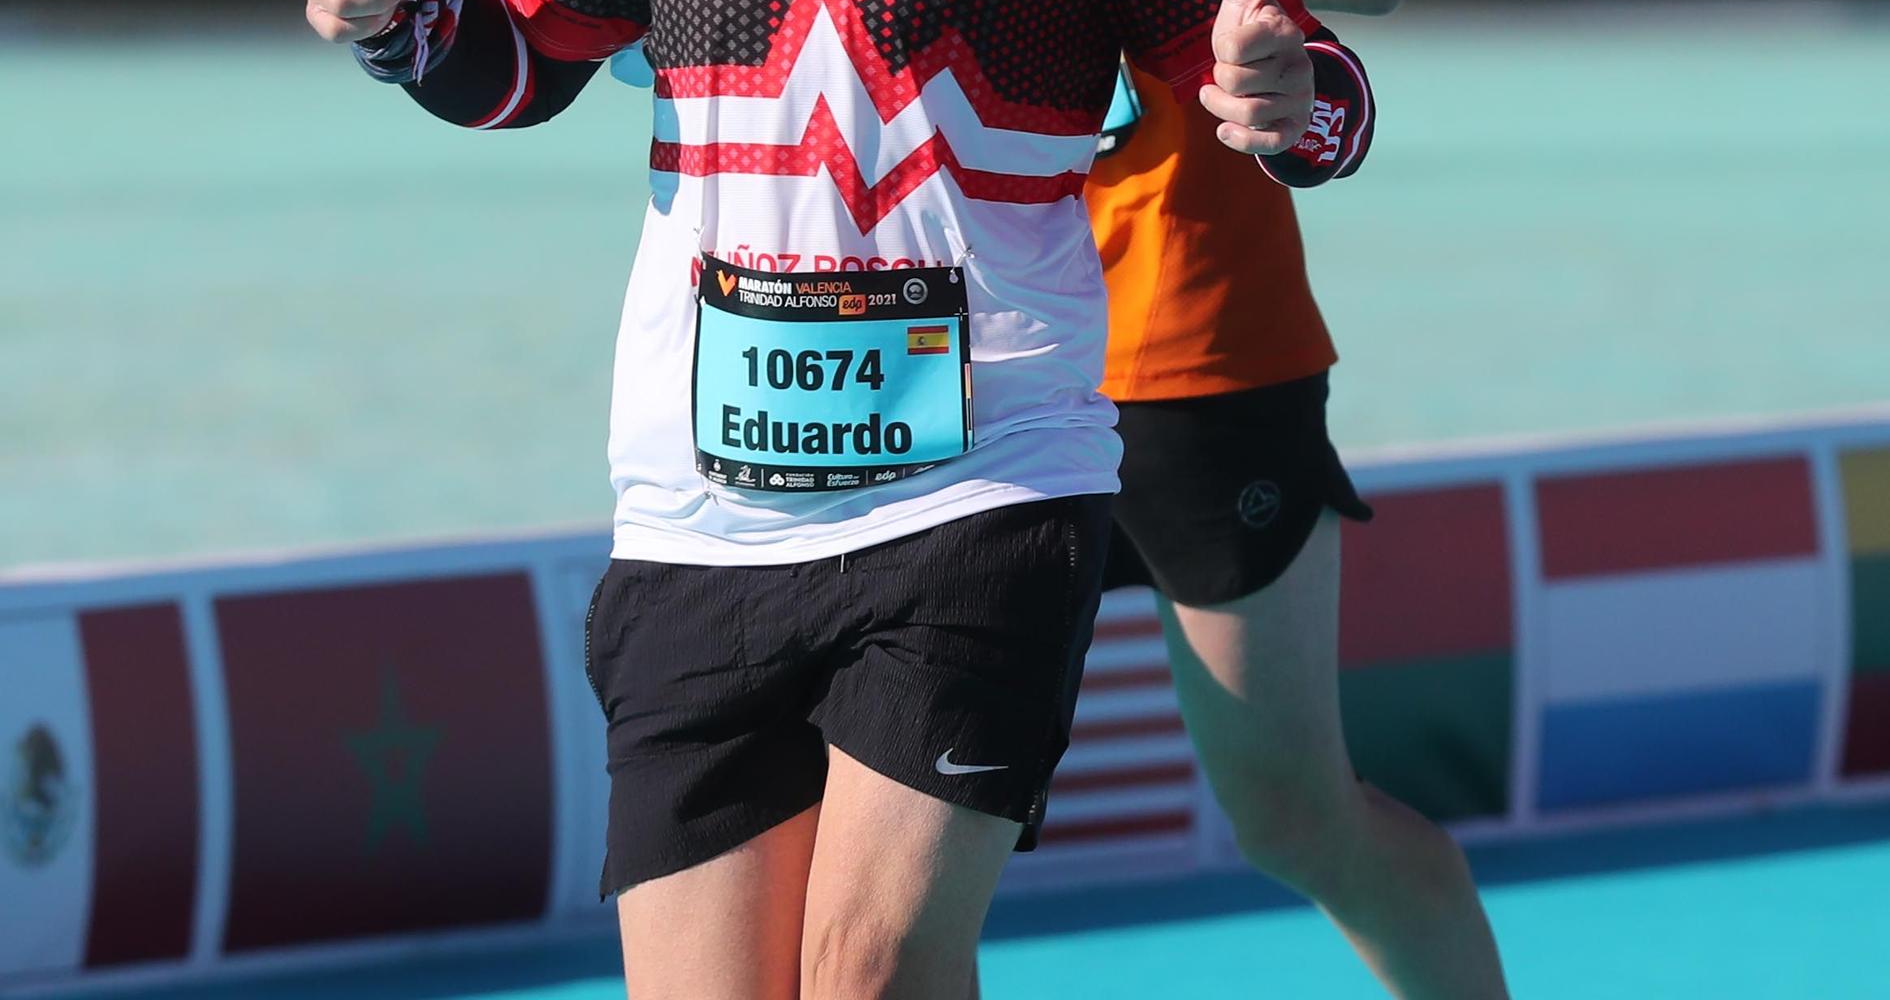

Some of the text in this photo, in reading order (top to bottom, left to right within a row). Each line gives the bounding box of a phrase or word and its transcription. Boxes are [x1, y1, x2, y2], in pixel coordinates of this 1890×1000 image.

[738, 276, 853, 295] MARATÓN VALENCIA
[738, 289, 783, 308] TRINIDAD
[784, 295, 837, 308] ALFONSO
[868, 293, 897, 306] 2021
[742, 346, 885, 391] 10674
[721, 403, 912, 455] Eduardo
